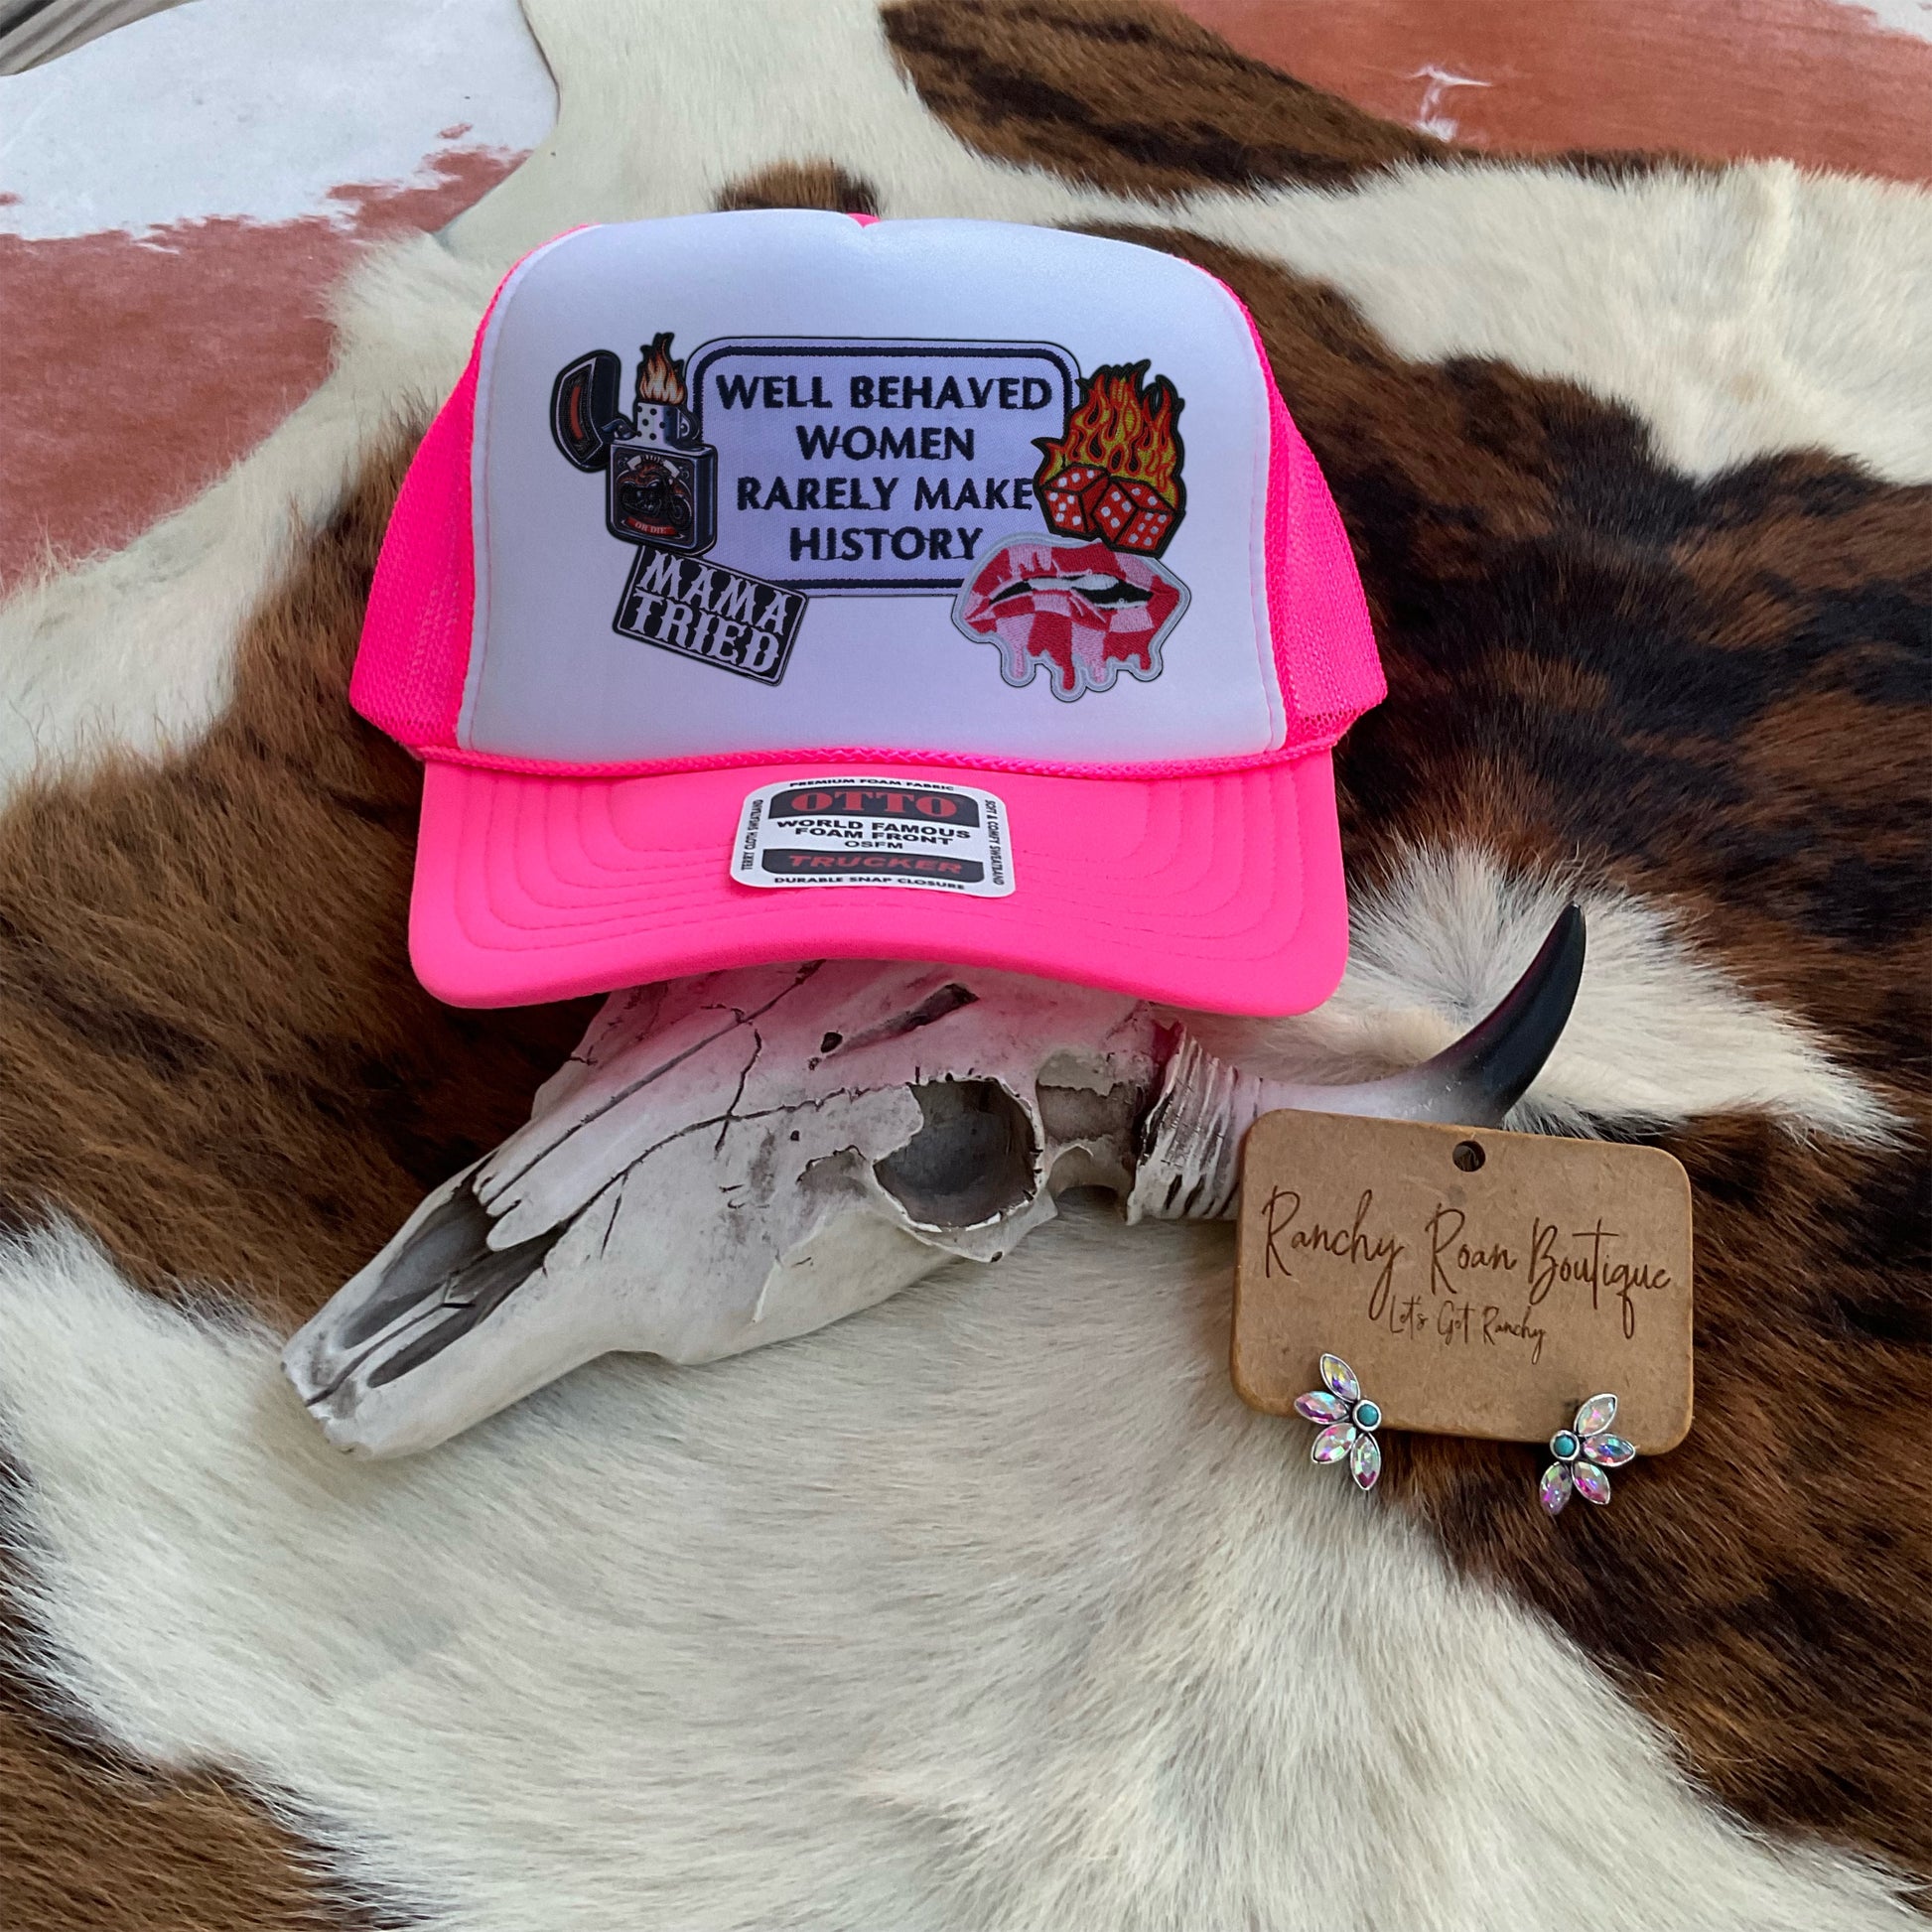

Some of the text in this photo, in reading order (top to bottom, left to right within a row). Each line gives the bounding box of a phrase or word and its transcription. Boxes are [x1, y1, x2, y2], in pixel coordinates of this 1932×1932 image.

[716, 374, 1052, 411] WELL BEHAVED
[796, 425, 975, 462] WOMEN
[737, 477, 1035, 511] RARELY MAKE
[634, 521, 668, 535] OR DIE
[789, 527, 983, 562] HISTORY
[635, 549, 793, 636] MAMA
[628, 587, 780, 673] TRIED
[789, 777, 955, 791] PREMIUM FOAM FABRIC
[790, 790, 958, 818] OTTO
[984, 799, 998, 814] SOFT
[776, 818, 971, 839] WORLD FAMOUS
[794, 827, 953, 846] FOAM FRONT
[988, 821, 1002, 845] COMFY
[745, 831, 758, 850] CLOTH
[844, 840, 903, 850] OSFM
[741, 850, 755, 872] TERRY
[788, 855, 963, 875] TRUCKER
[897, 878, 965, 891] CLOSURE
[1262, 1184, 1672, 1339] Ranchy Roan Boutique
[1390, 1295, 1430, 1340] Let's
[1482, 1305, 1547, 1365] Ranchy
